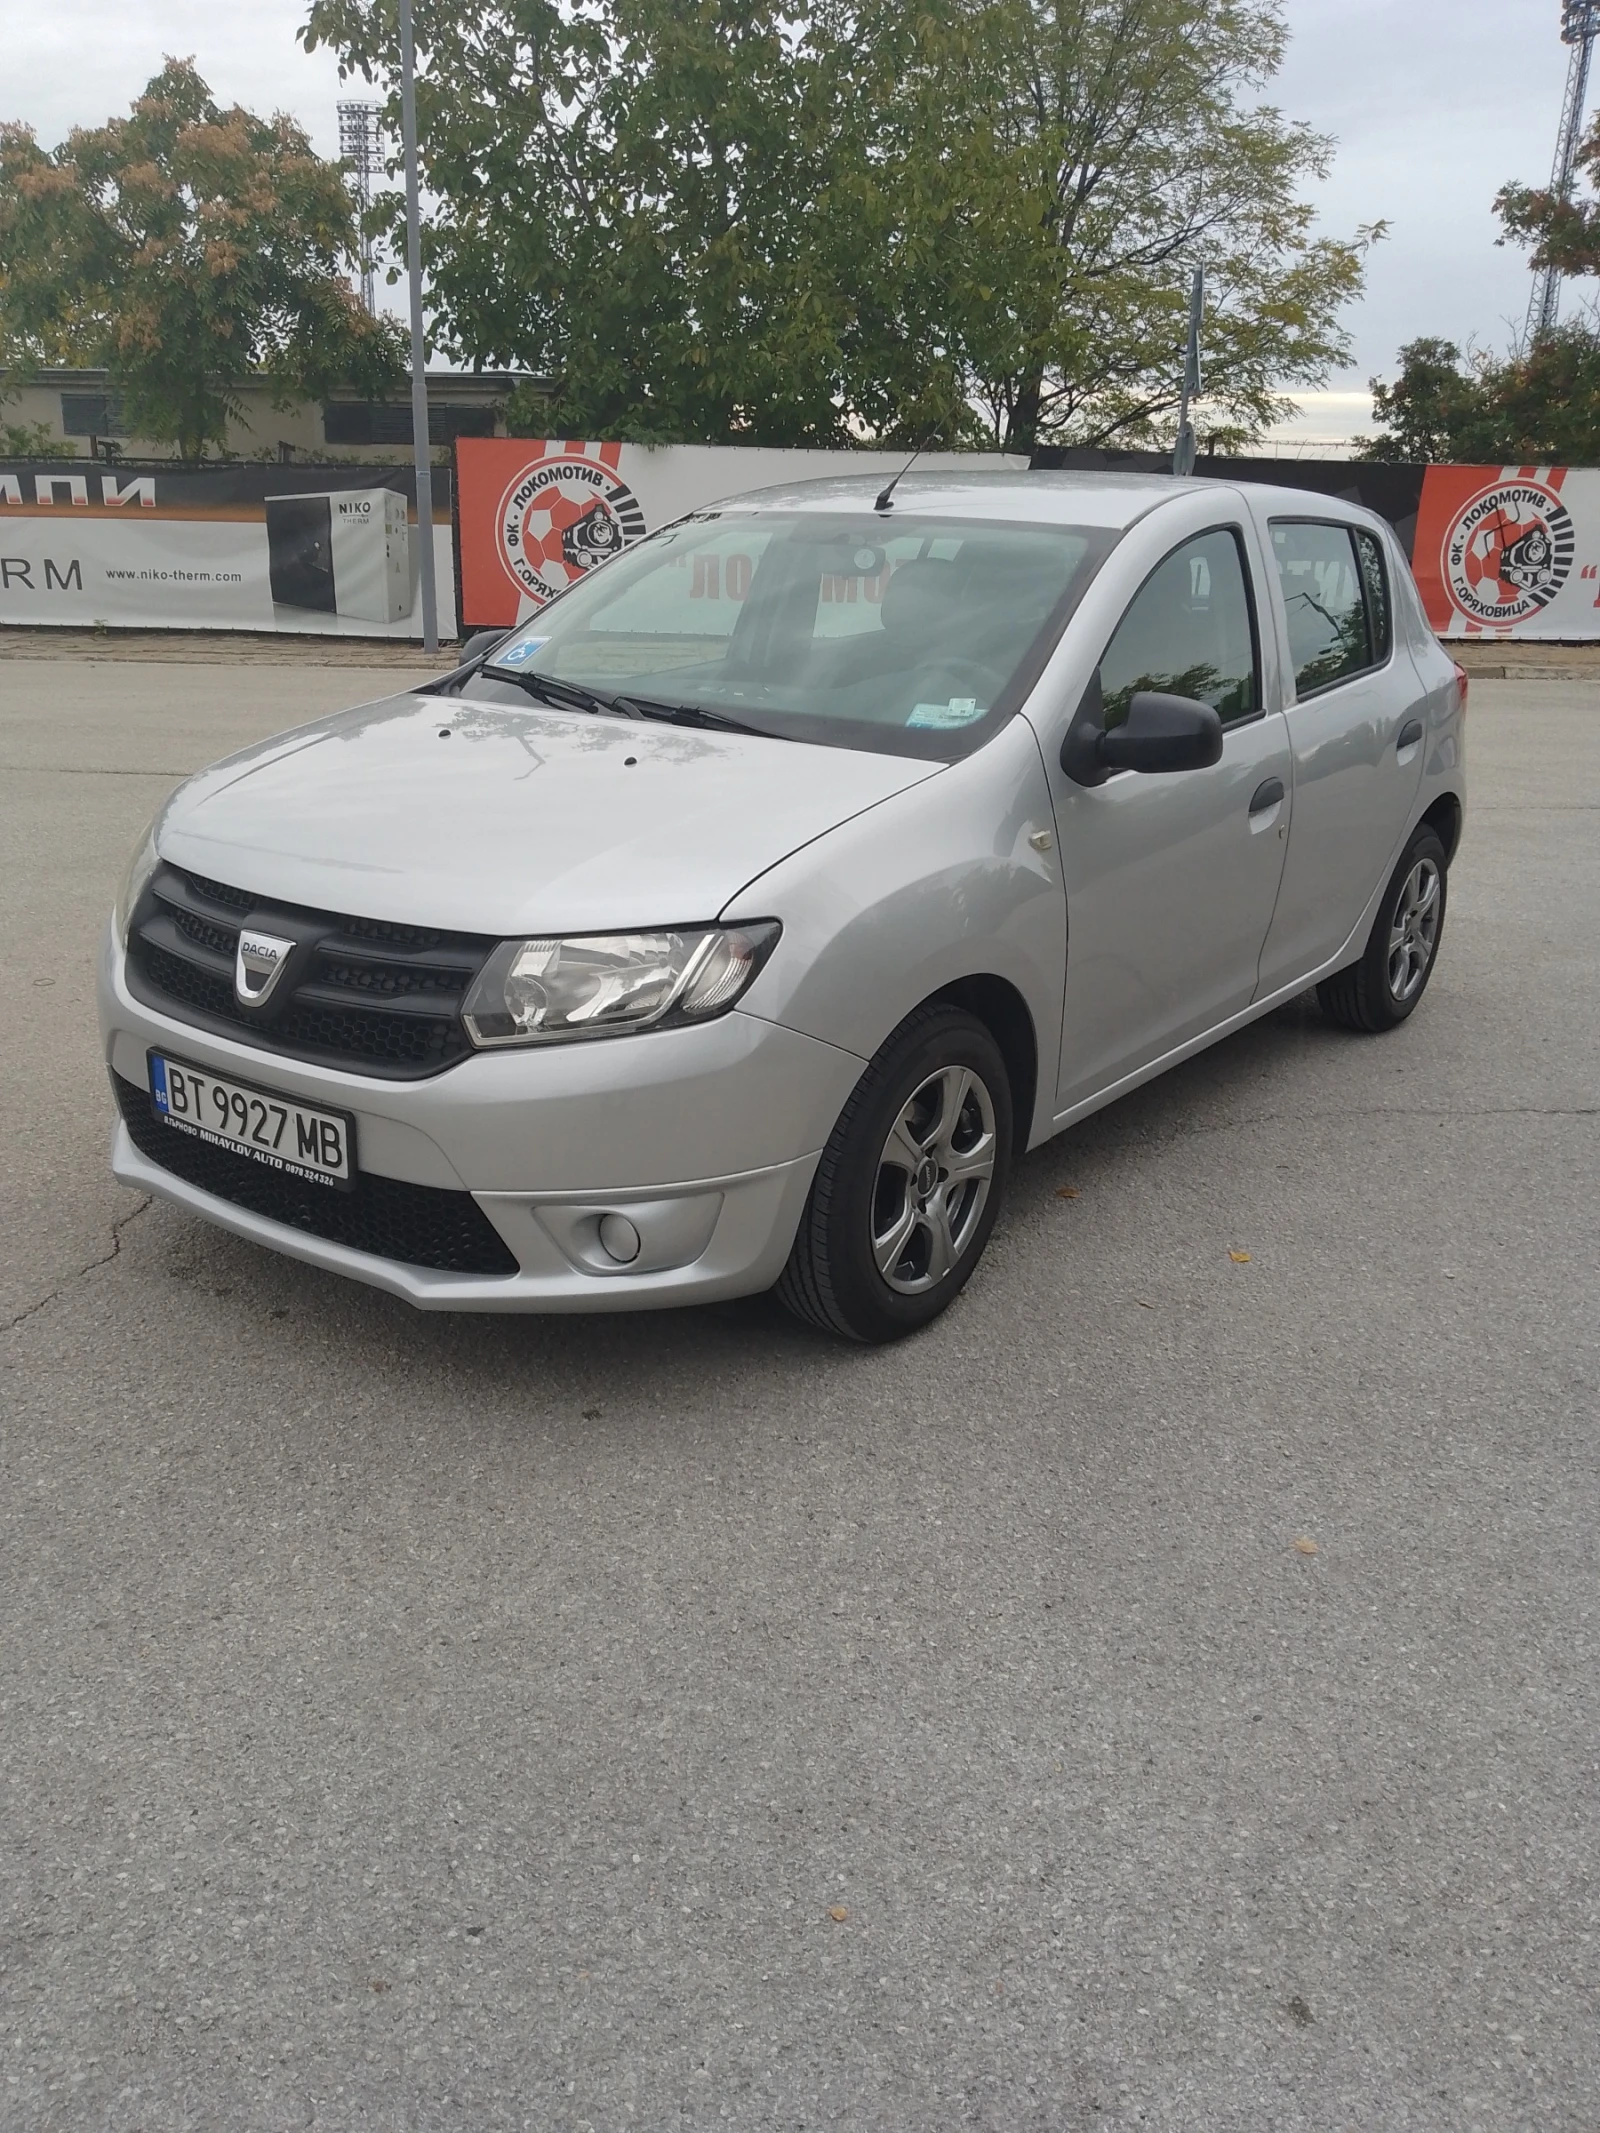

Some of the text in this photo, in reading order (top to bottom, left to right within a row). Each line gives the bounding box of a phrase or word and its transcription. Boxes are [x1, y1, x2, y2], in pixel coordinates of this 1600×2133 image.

[338, 501, 371, 514] NIKO
[506, 465, 604, 547] ФК ЛОКОМОТИВ
[1451, 489, 1547, 566] ФК ЛОКОМОТИВ
[105, 568, 242, 582] www.niko-therm.com
[242, 942, 277, 960] DACIA
[155, 1089, 167, 1105] BG
[169, 1067, 342, 1169] BT 9927 MB
[200, 1129, 252, 1157] MIHAYLOV
[253, 1150, 283, 1169] AUTO
